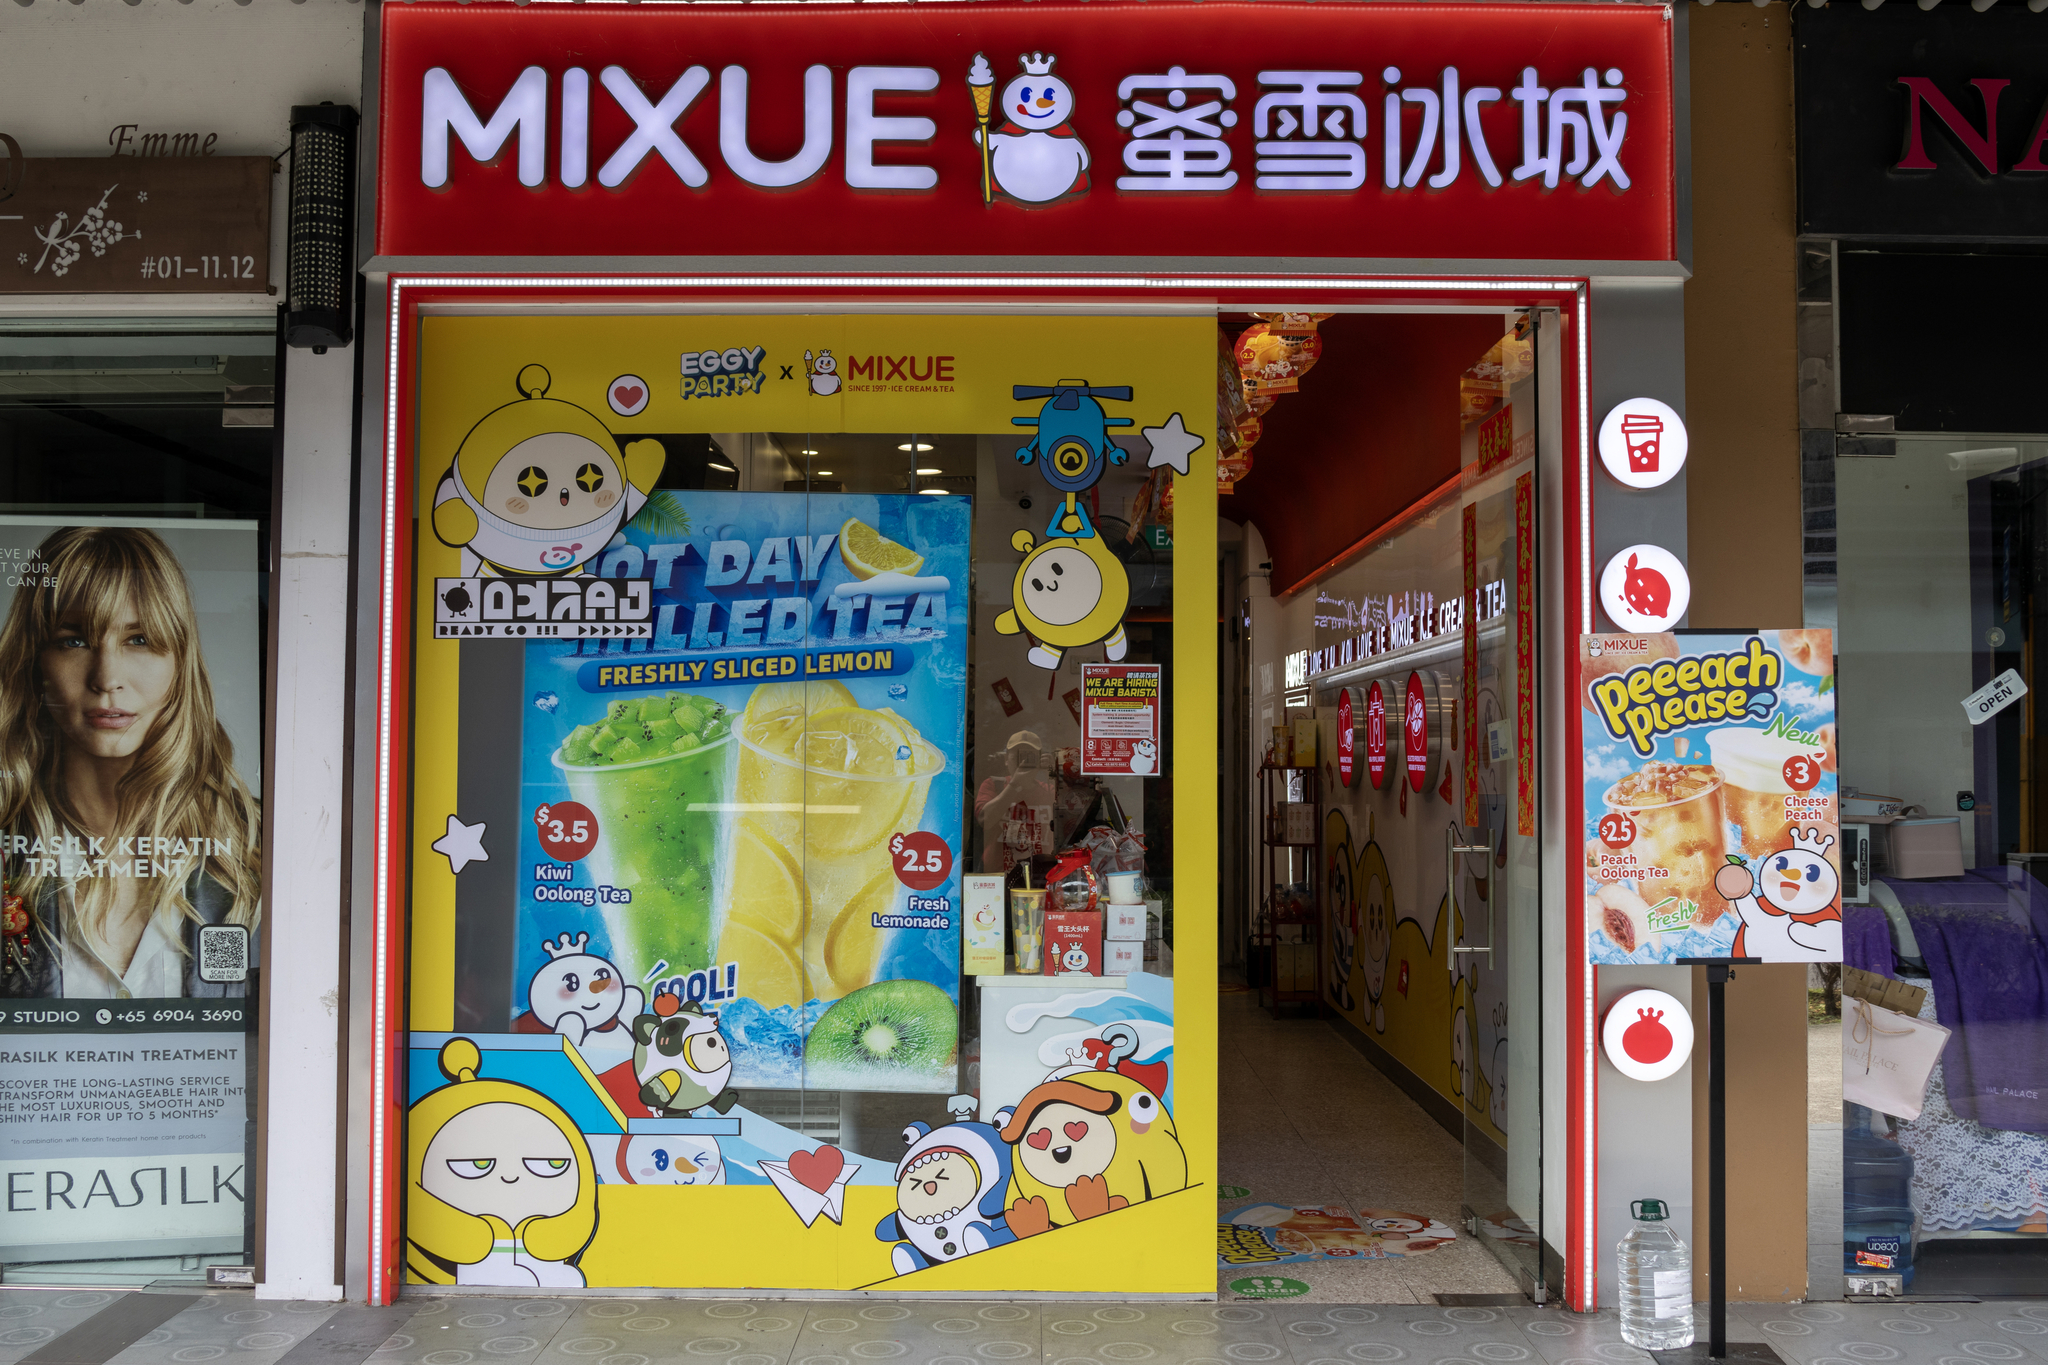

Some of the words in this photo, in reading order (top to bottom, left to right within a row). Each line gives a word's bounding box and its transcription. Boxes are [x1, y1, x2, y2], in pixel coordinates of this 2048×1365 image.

[421, 64, 940, 190] MIXUE
[1116, 65, 1631, 191] 蜜雪冰城
[108, 124, 218, 157] Emme
[140, 256, 255, 279] #01-11.12
[680, 345, 767, 377] EGGY
[848, 355, 955, 381] MIXUE
[680, 371, 767, 400] PARTY
[848, 385, 870, 393] SINCE
[890, 385, 903, 393] ICE
[905, 385, 932, 393] CREAM
[28, 549, 41, 559] IN
[12, 562, 49, 573] YOUR
[585, 543, 692, 590] OT
[704, 534, 839, 587] DAY
[7, 576, 36, 587] CAN
[43, 577, 58, 588] BE
[824, 591, 948, 642] TEA
[1357, 630, 1373, 661] LOVE
[1390, 614, 1415, 650] MIXUE
[1439, 595, 1464, 636] CREA
[1485, 578, 1506, 621] TEA
[439, 625, 495, 636] READY
[504, 625, 527, 636] GO
[1604, 639, 1648, 650] MIXUE
[599, 660, 706, 687] FRESHLY
[713, 655, 797, 681] SLICED
[804, 650, 893, 677] LEMON
[1085, 678, 1102, 687] WE
[1104, 678, 1124, 687] ARE
[1126, 678, 1158, 688] HIRING
[1085, 687, 1115, 697] MIXUE
[1117, 687, 1157, 697] BARISTA
[1979, 686, 2013, 713] OPEN
[1762, 713, 1820, 746] New
[1785, 796, 1829, 808] Cheese
[1785, 808, 1823, 820] Peach
[118, 836, 232, 856] KERATIN
[1601, 854, 1637, 865] Peach
[26, 858, 186, 878] TREATMENT
[535, 864, 572, 881] Kiwi
[1601, 867, 1645, 880] Oolong
[1648, 867, 1669, 878] Tea
[534, 886, 595, 905] Oolong
[600, 887, 631, 903] Tea
[908, 897, 949, 911] Fresh
[872, 913, 949, 929] Lemonade
[1646, 901, 1692, 930] Fresh
[1057, 925, 1090, 933] 雪王大头杯
[13, 1011, 80, 1023] STUDIO
[116, 1010, 146, 1022] +65
[152, 1010, 195, 1022] 6904
[201, 1010, 243, 1022] 3690
[1, 1051, 58, 1063] RASILK
[66, 1050, 134, 1063] KERATIN
[141, 1049, 238, 1061] TREATMENT
[1843, 1045, 1858, 1057] AIL
[1861, 1051, 1898, 1071] PLACE
[54, 1079, 77, 1088] THE
[82, 1077, 175, 1088] LONG-LASTING
[180, 1076, 230, 1086] SERVICE
[0, 1091, 74, 1101] TRANSFORM
[80, 1088, 183, 1099] UNMANAGEABLE
[189, 1088, 219, 1097] HAIR
[2002, 1087, 2039, 1099] PALACE
[20, 1102, 56, 1111] MOST
[60, 1101, 133, 1111] LUXURIOUS,
[138, 1099, 193, 1109] SMOOTH
[198, 1098, 225, 1108] AND
[41, 1113, 71, 1123] HAIR
[77, 1112, 101, 1122] FOR
[107, 1112, 122, 1121] UP
[127, 1112, 144, 1121] TO
[149, 1111, 156, 1120] 5
[7, 1164, 244, 1212] ERASILK
[1867, 1242, 1899, 1253] Ocean
